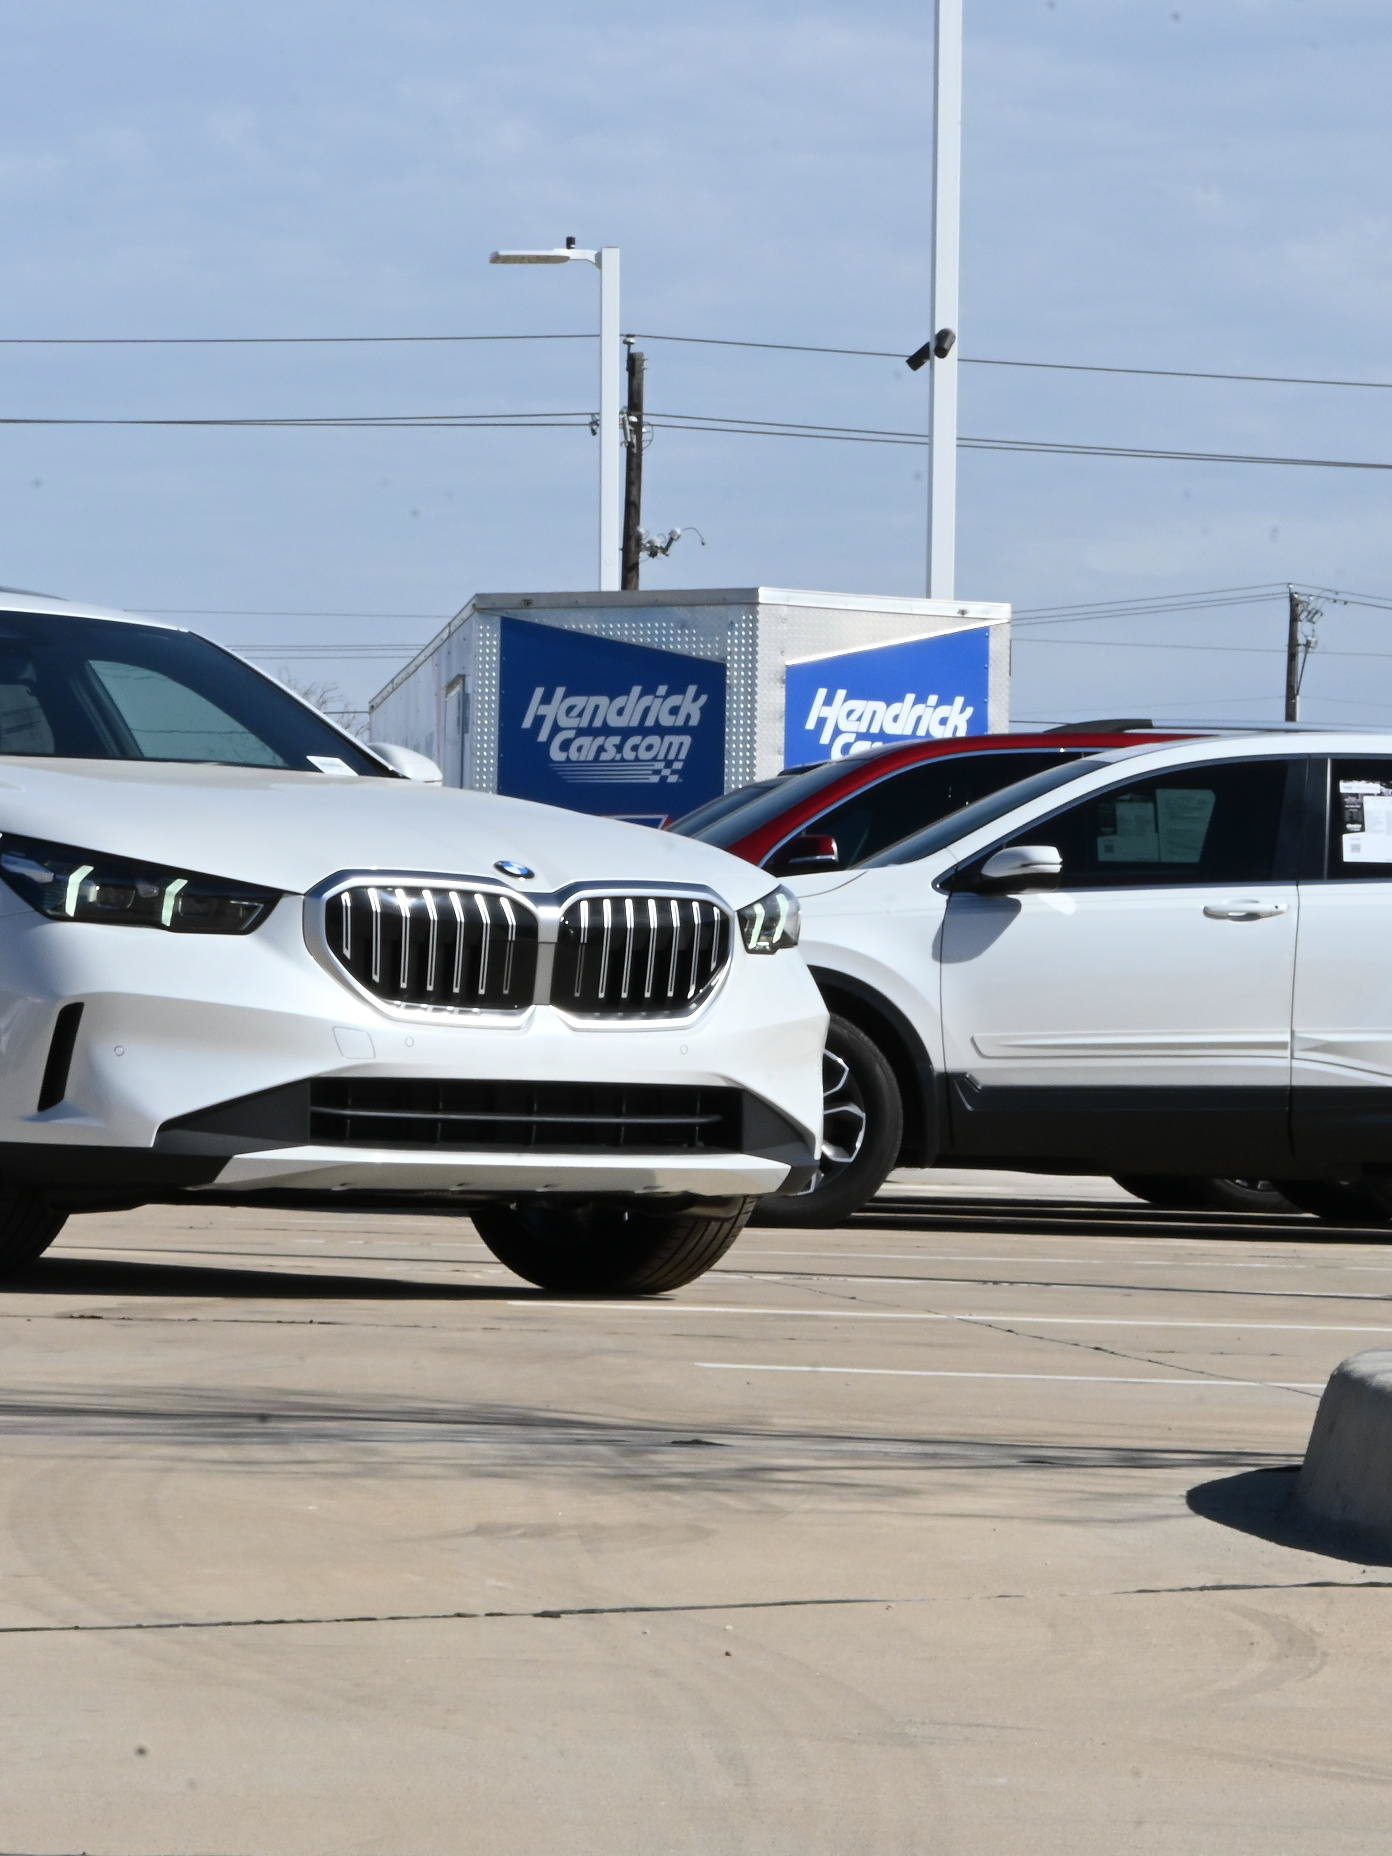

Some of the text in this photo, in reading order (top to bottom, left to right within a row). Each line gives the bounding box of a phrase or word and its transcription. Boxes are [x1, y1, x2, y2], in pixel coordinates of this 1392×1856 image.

[521, 685, 708, 742] Hendrick
[805, 688, 974, 745] Hendrick
[549, 729, 692, 761] Cars.com
